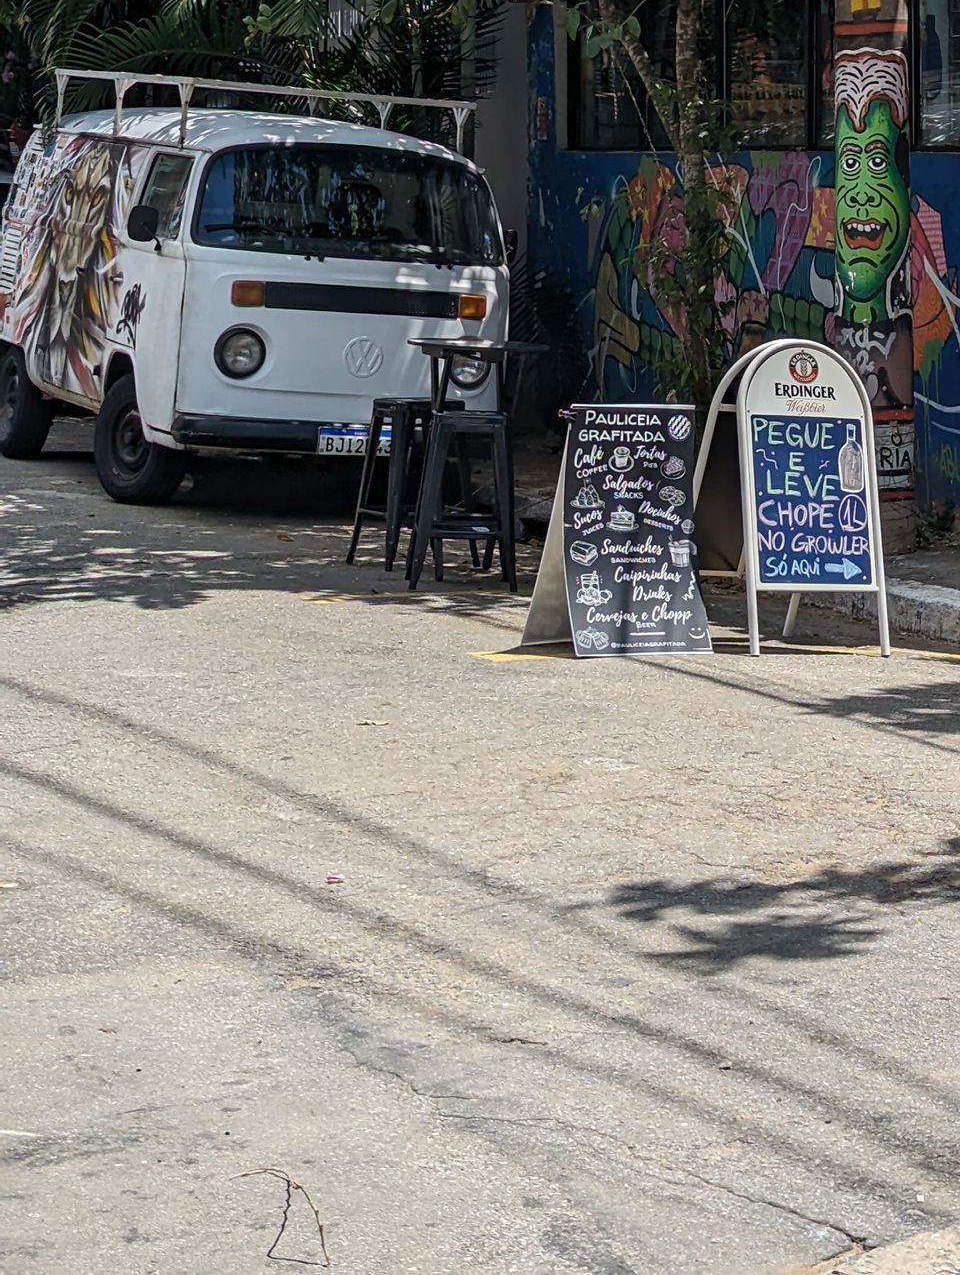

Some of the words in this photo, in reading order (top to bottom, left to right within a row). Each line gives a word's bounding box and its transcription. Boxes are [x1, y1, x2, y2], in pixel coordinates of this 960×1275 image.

[774, 382, 837, 401] ERDINGER
[585, 410, 662, 425] PAULICEIA
[578, 429, 666, 443] GRAFITADA
[752, 417, 836, 450] PEGUE
[574, 445, 604, 468] Café
[634, 445, 667, 460] Tortas
[789, 452, 806, 472] E
[576, 464, 608, 478] COFFEE
[602, 474, 654, 495] Salgados
[613, 491, 644, 499] SNACKS
[766, 468, 841, 501] LEVE
[573, 509, 603, 529] Sucos
[638, 500, 683, 525] Docinhos
[758, 499, 835, 529] CHOPE
[757, 529, 785, 552] NO
[791, 532, 871, 555] GROWLER
[614, 562, 682, 586] Caipirinhas
[765, 553, 788, 577] SÓ
[632, 585, 673, 602] Drinks
[586, 606, 638, 627] Cervejas
[641, 611, 649, 620] e
[652, 602, 693, 625] Chopp
